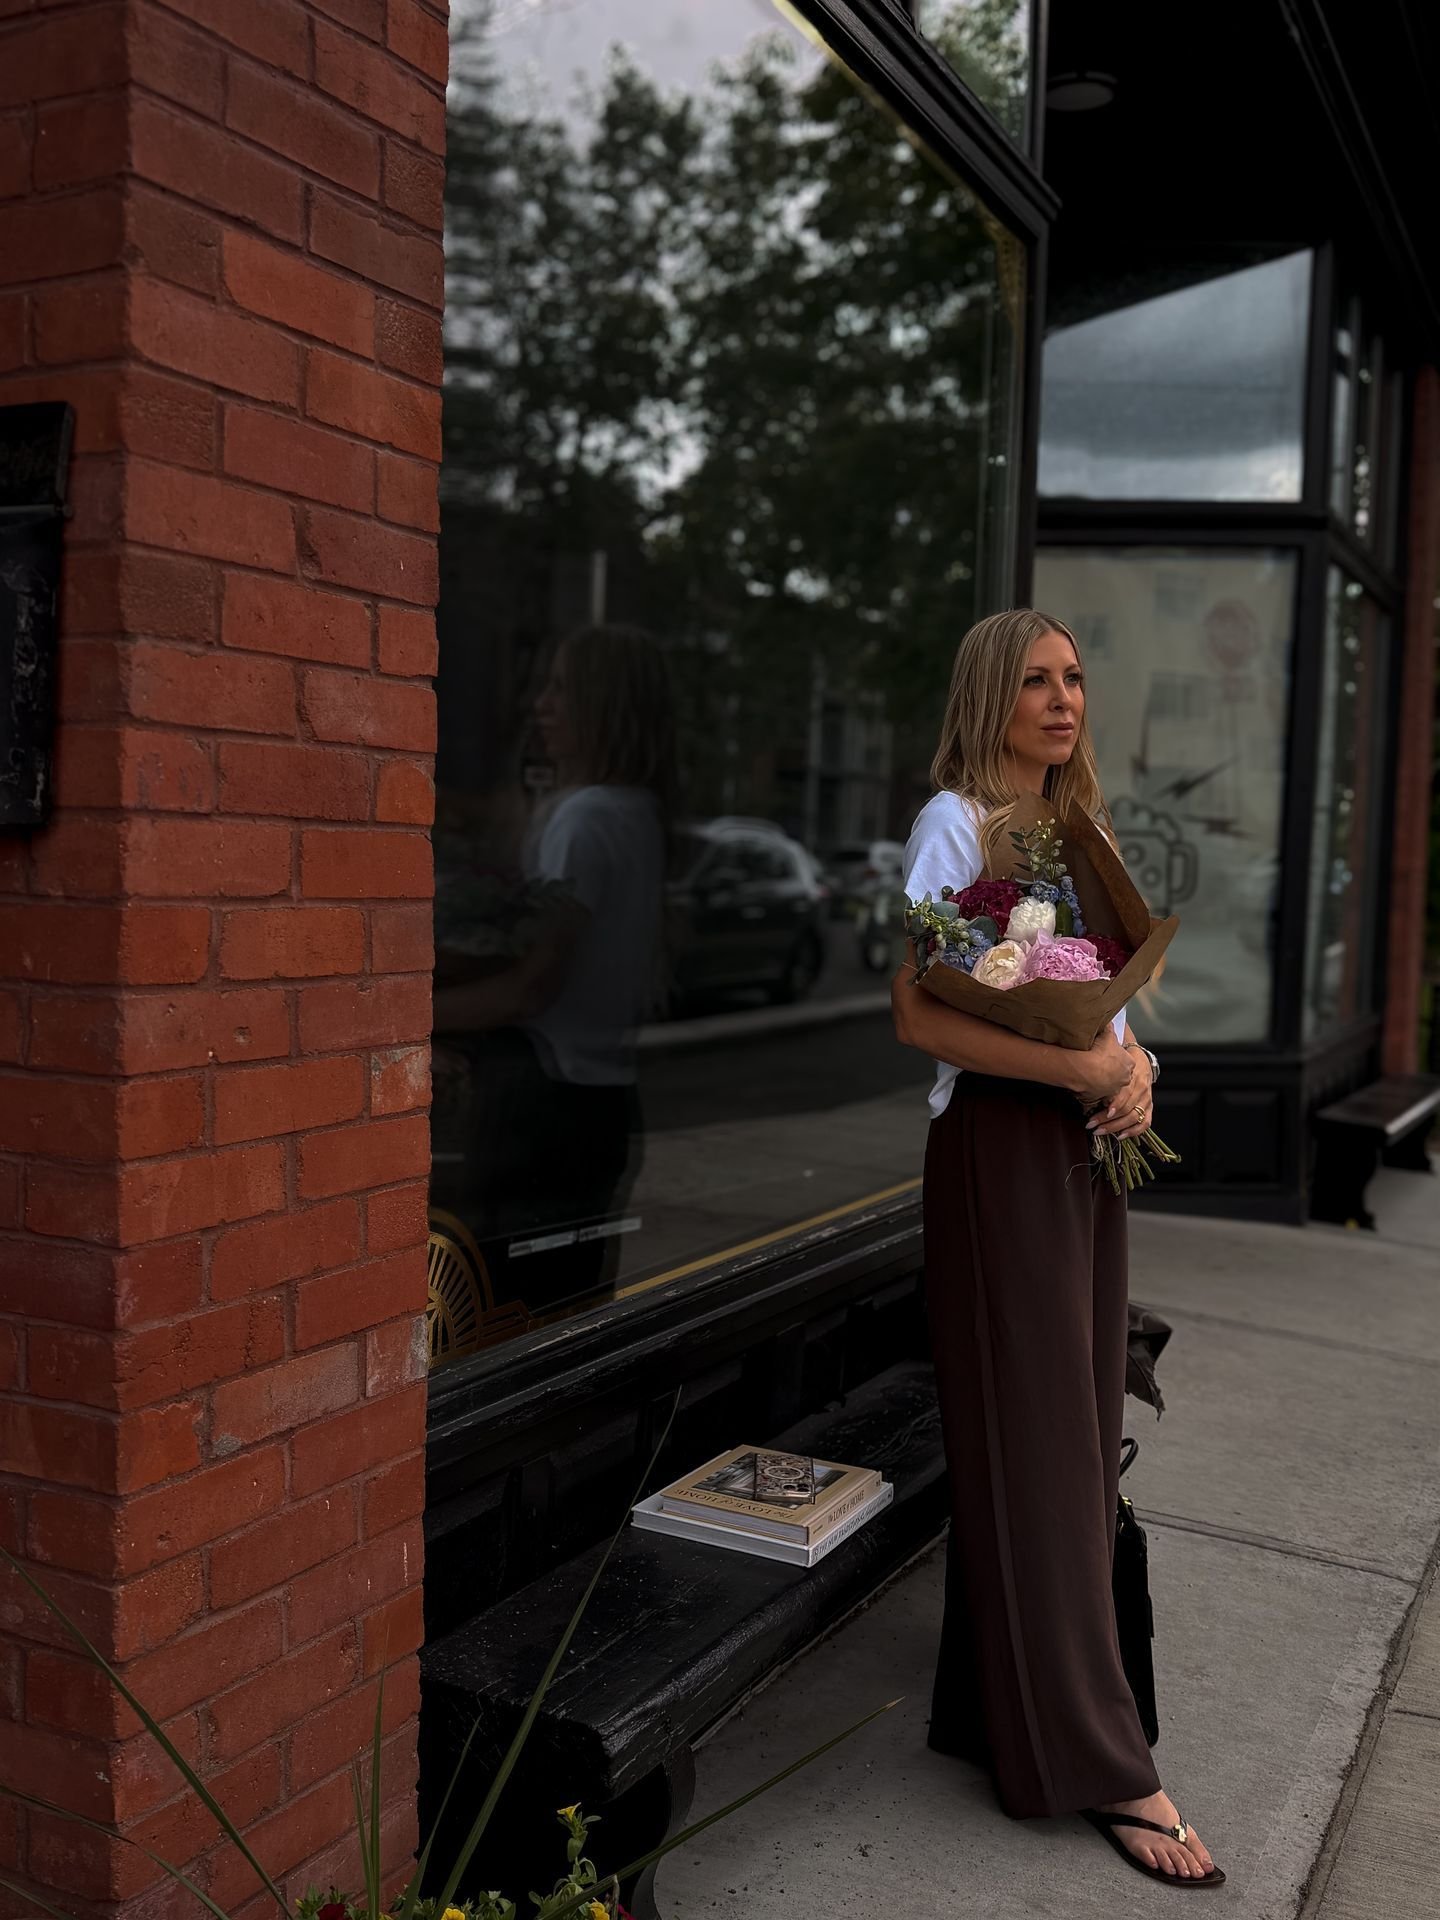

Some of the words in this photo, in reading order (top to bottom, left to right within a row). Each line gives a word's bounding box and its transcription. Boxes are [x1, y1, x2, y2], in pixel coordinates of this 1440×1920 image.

[674, 1489, 717, 1502] HOME
[736, 1501, 771, 1514] LOVE
[833, 1503, 846, 1521] LOVE
[850, 1489, 865, 1508] HOME
